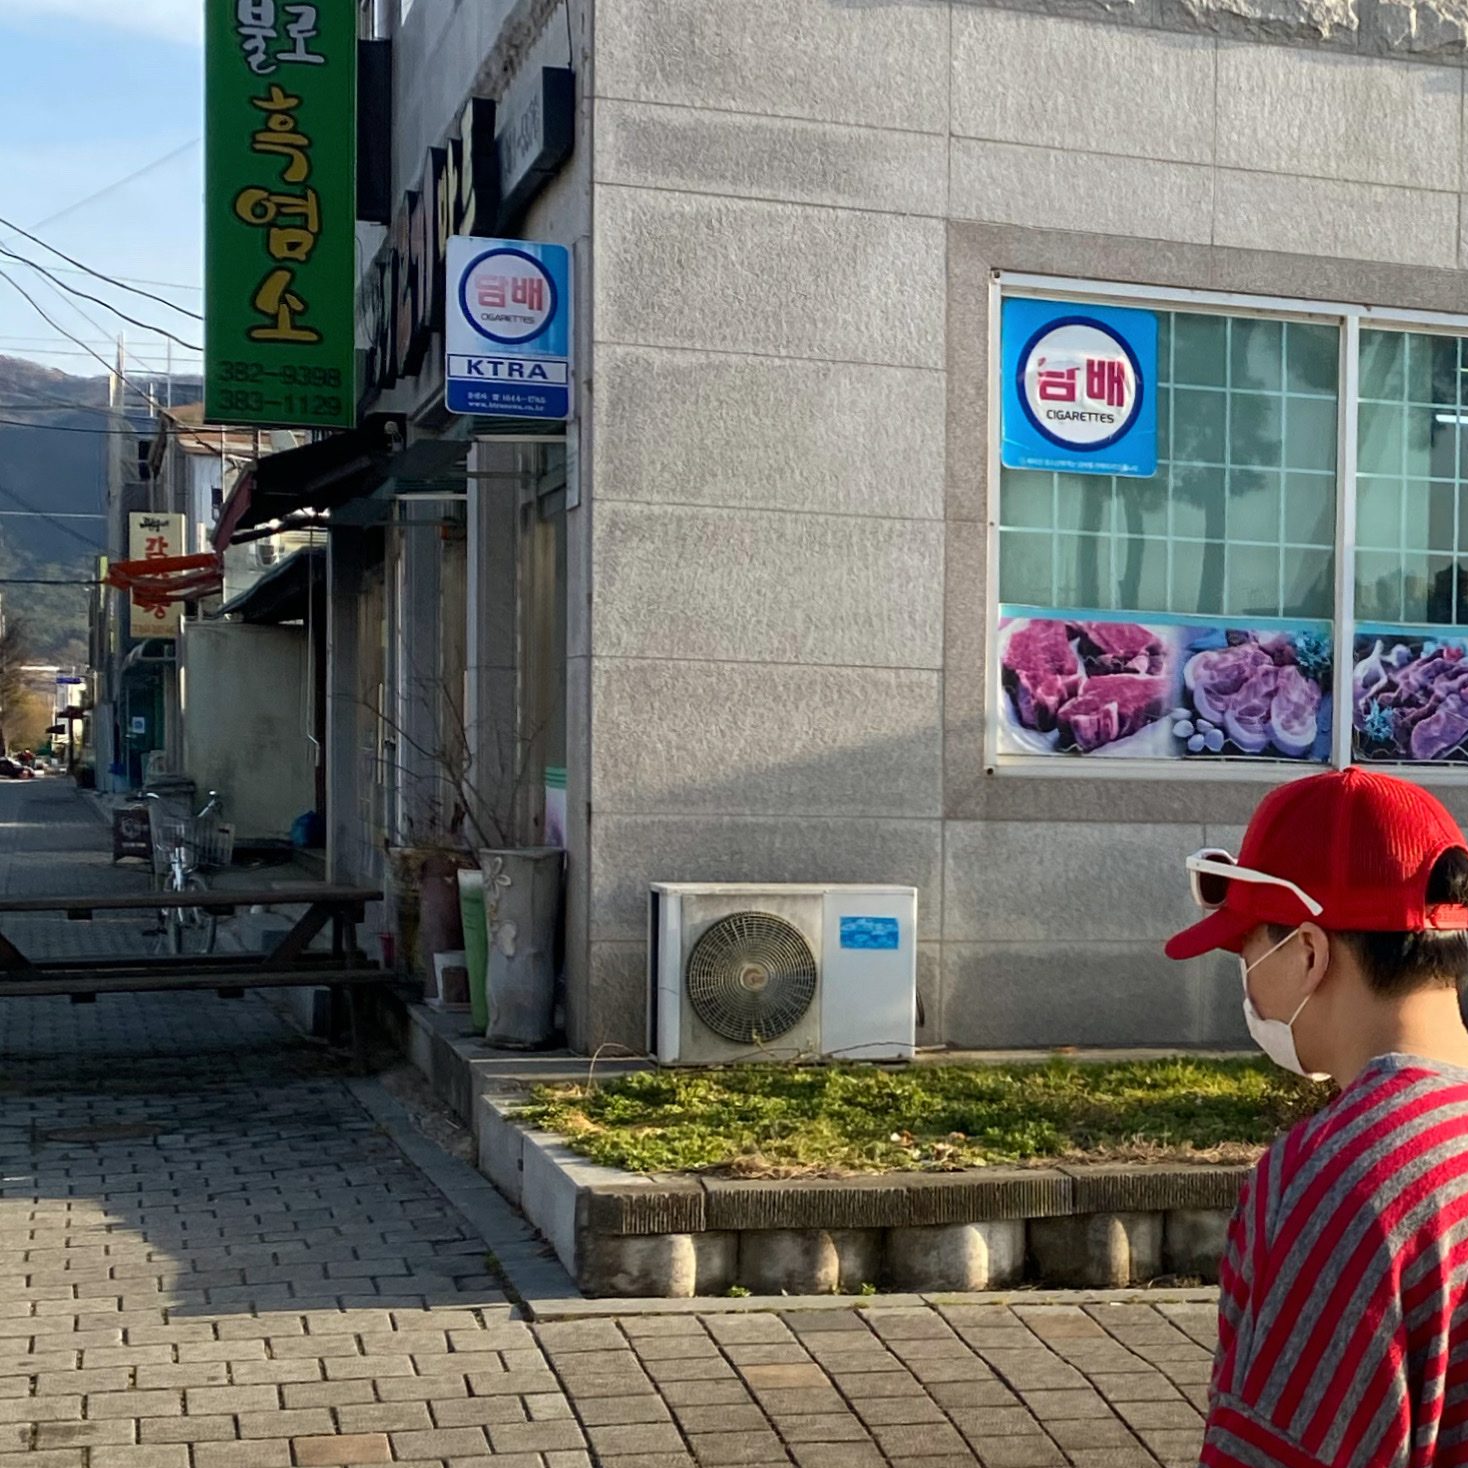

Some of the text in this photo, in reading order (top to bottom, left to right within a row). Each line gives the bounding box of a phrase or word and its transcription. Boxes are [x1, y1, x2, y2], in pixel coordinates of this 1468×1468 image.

[235, 85, 319, 341] 흑염소
[474, 273, 544, 312] 담배
[466, 359, 549, 380] KTRA
[1046, 409, 1115, 424] CIGARETTES
